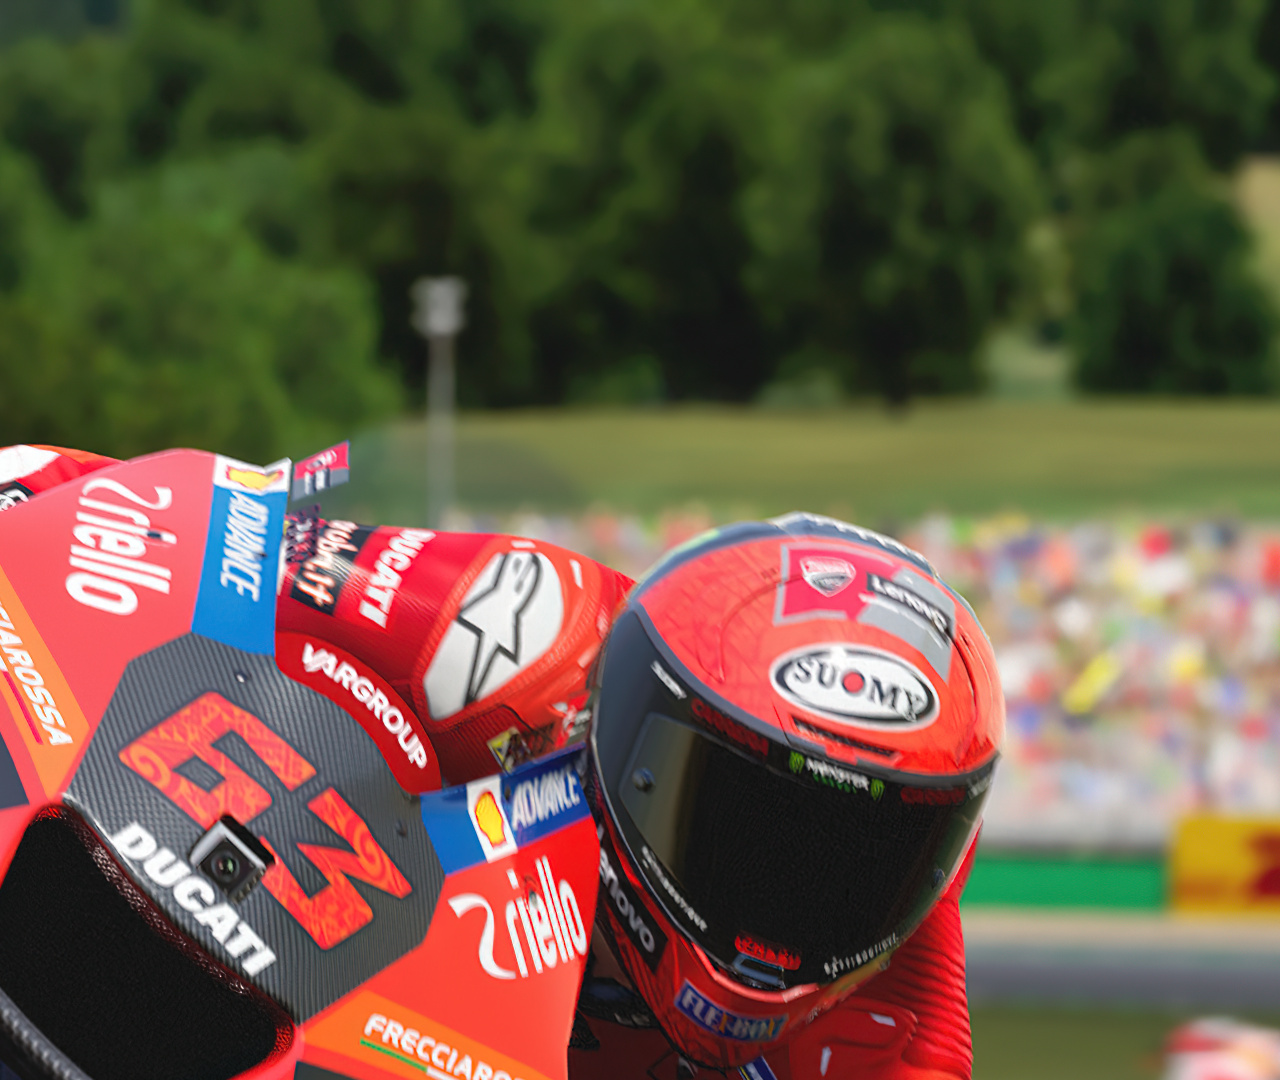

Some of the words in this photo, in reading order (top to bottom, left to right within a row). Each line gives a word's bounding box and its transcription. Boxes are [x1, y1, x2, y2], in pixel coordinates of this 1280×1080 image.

[65, 496, 178, 615] riello
[220, 491, 269, 602] ADVANCE
[302, 643, 428, 770] VARGROUP
[512, 764, 581, 831] ADVANCE
[112, 821, 277, 977] DUCATI
[505, 855, 587, 978] riello
